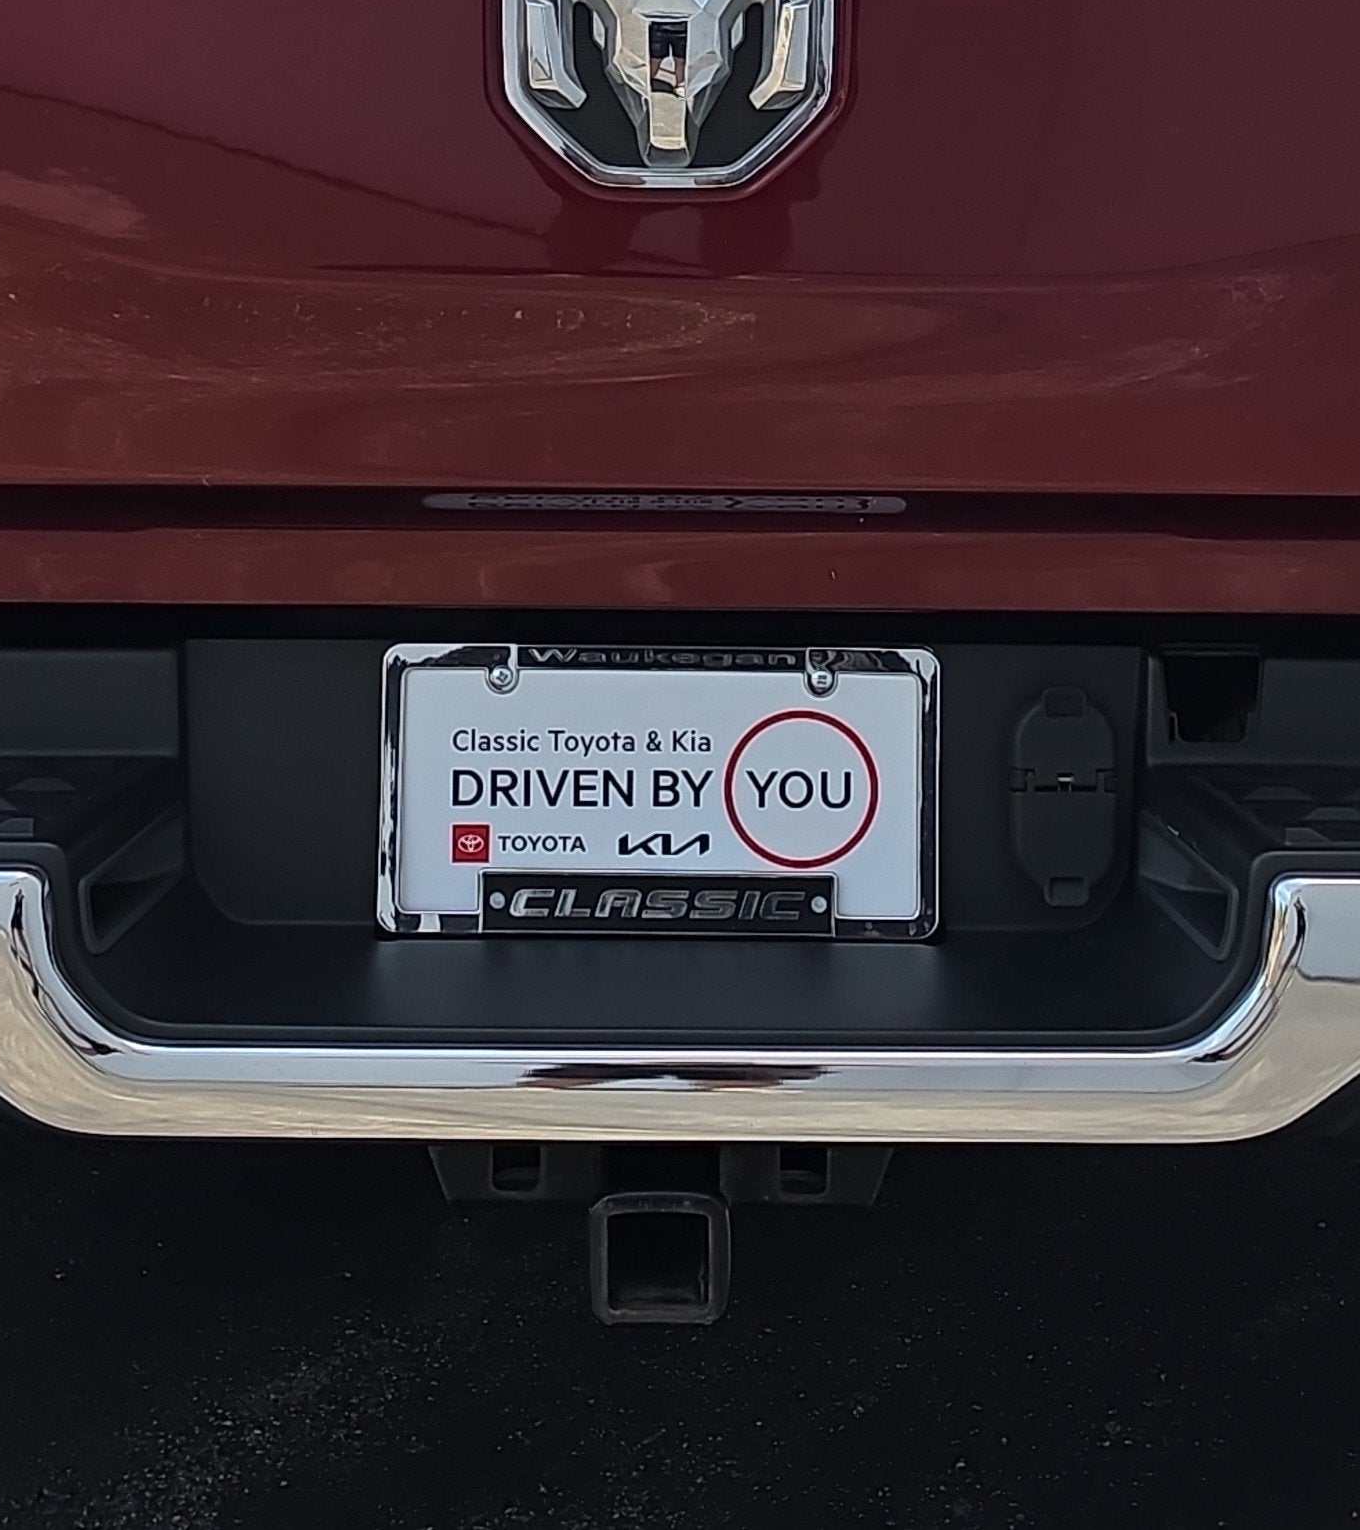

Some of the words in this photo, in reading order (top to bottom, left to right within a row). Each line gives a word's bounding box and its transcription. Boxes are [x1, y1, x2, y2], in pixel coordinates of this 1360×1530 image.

[528, 648, 796, 668] Waukegan
[452, 729, 540, 753] Classic
[548, 730, 636, 757] Toyota
[646, 730, 662, 752] &
[672, 730, 712, 752] Kia
[452, 769, 634, 807] DRIVEN
[653, 770, 714, 808] BY
[745, 770, 852, 809] YOU
[498, 836, 586, 853] TOYOTA
[508, 888, 806, 920] CLASSIC
